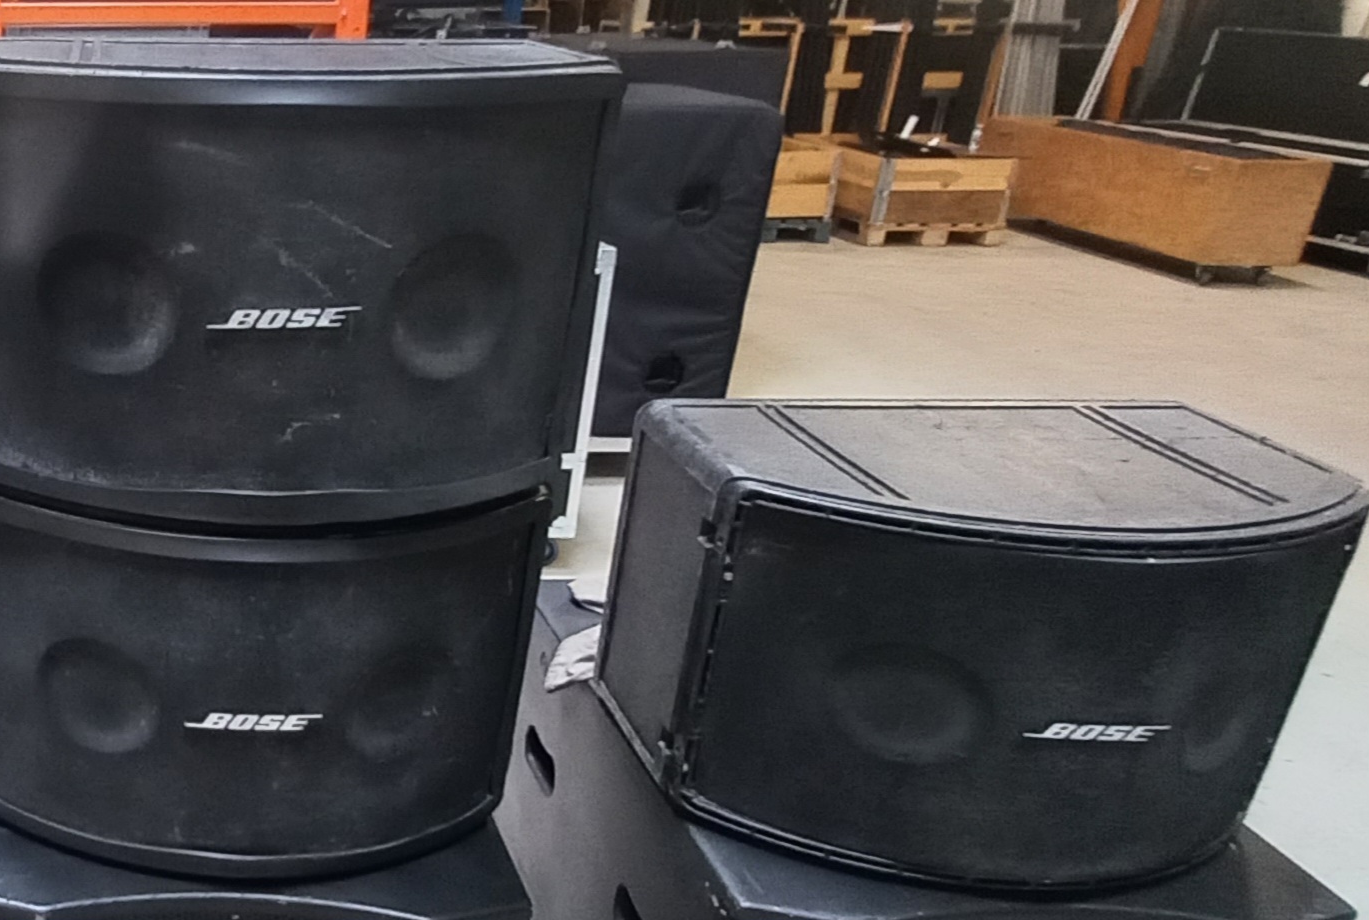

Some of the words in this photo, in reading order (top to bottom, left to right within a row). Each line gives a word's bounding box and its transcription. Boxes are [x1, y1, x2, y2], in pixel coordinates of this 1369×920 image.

[206, 305, 362, 329] BOSE
[183, 712, 324, 731] BOSE
[1022, 722, 1172, 742] BOSE
